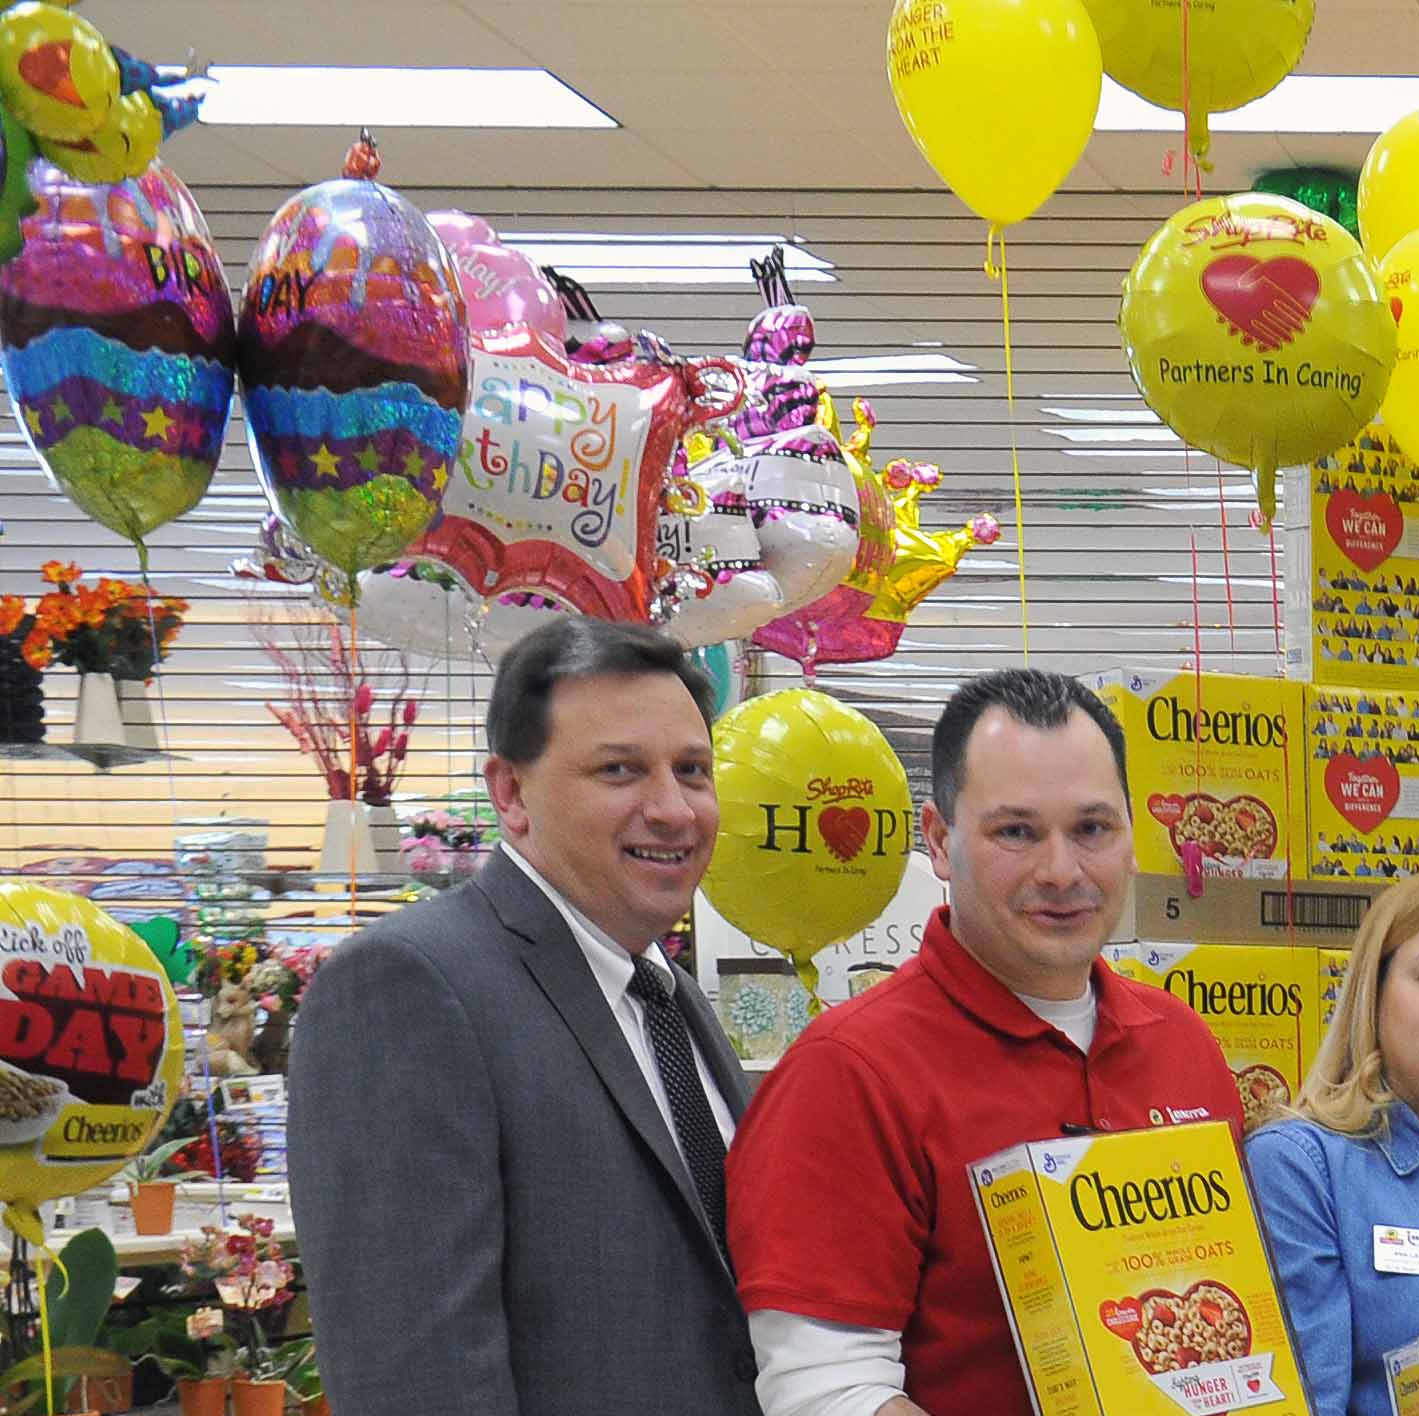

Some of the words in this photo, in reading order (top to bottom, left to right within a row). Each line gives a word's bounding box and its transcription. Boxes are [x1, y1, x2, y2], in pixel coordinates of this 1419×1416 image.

[921, 21, 954, 45] THE
[1159, 357, 1254, 385] Partners
[1262, 360, 1290, 386] In
[1296, 362, 1362, 399] Caring
[471, 372, 618, 472] appy
[1342, 519, 1360, 534] WE
[1363, 520, 1387, 537] CAN
[1147, 695, 1287, 749] Cheerios
[1245, 767, 1281, 782] OATS
[807, 777, 876, 804] ShopRite
[1340, 782, 1359, 798] WE
[1362, 783, 1385, 798] CAN
[1165, 897, 1181, 919] 5
[53, 929, 87, 965] off
[1162, 968, 1304, 1017] Cheerios
[0, 998, 166, 1084] DAY
[1260, 1037, 1295, 1050] OATS
[63, 1114, 145, 1144] Cheerios
[1070, 1169, 1232, 1233] Cheerios
[1122, 1251, 1165, 1272] 100%
[1194, 1240, 1235, 1261] OATS
[1184, 1377, 1229, 1399] HUNGER
[1204, 1394, 1235, 1409] HEART!
